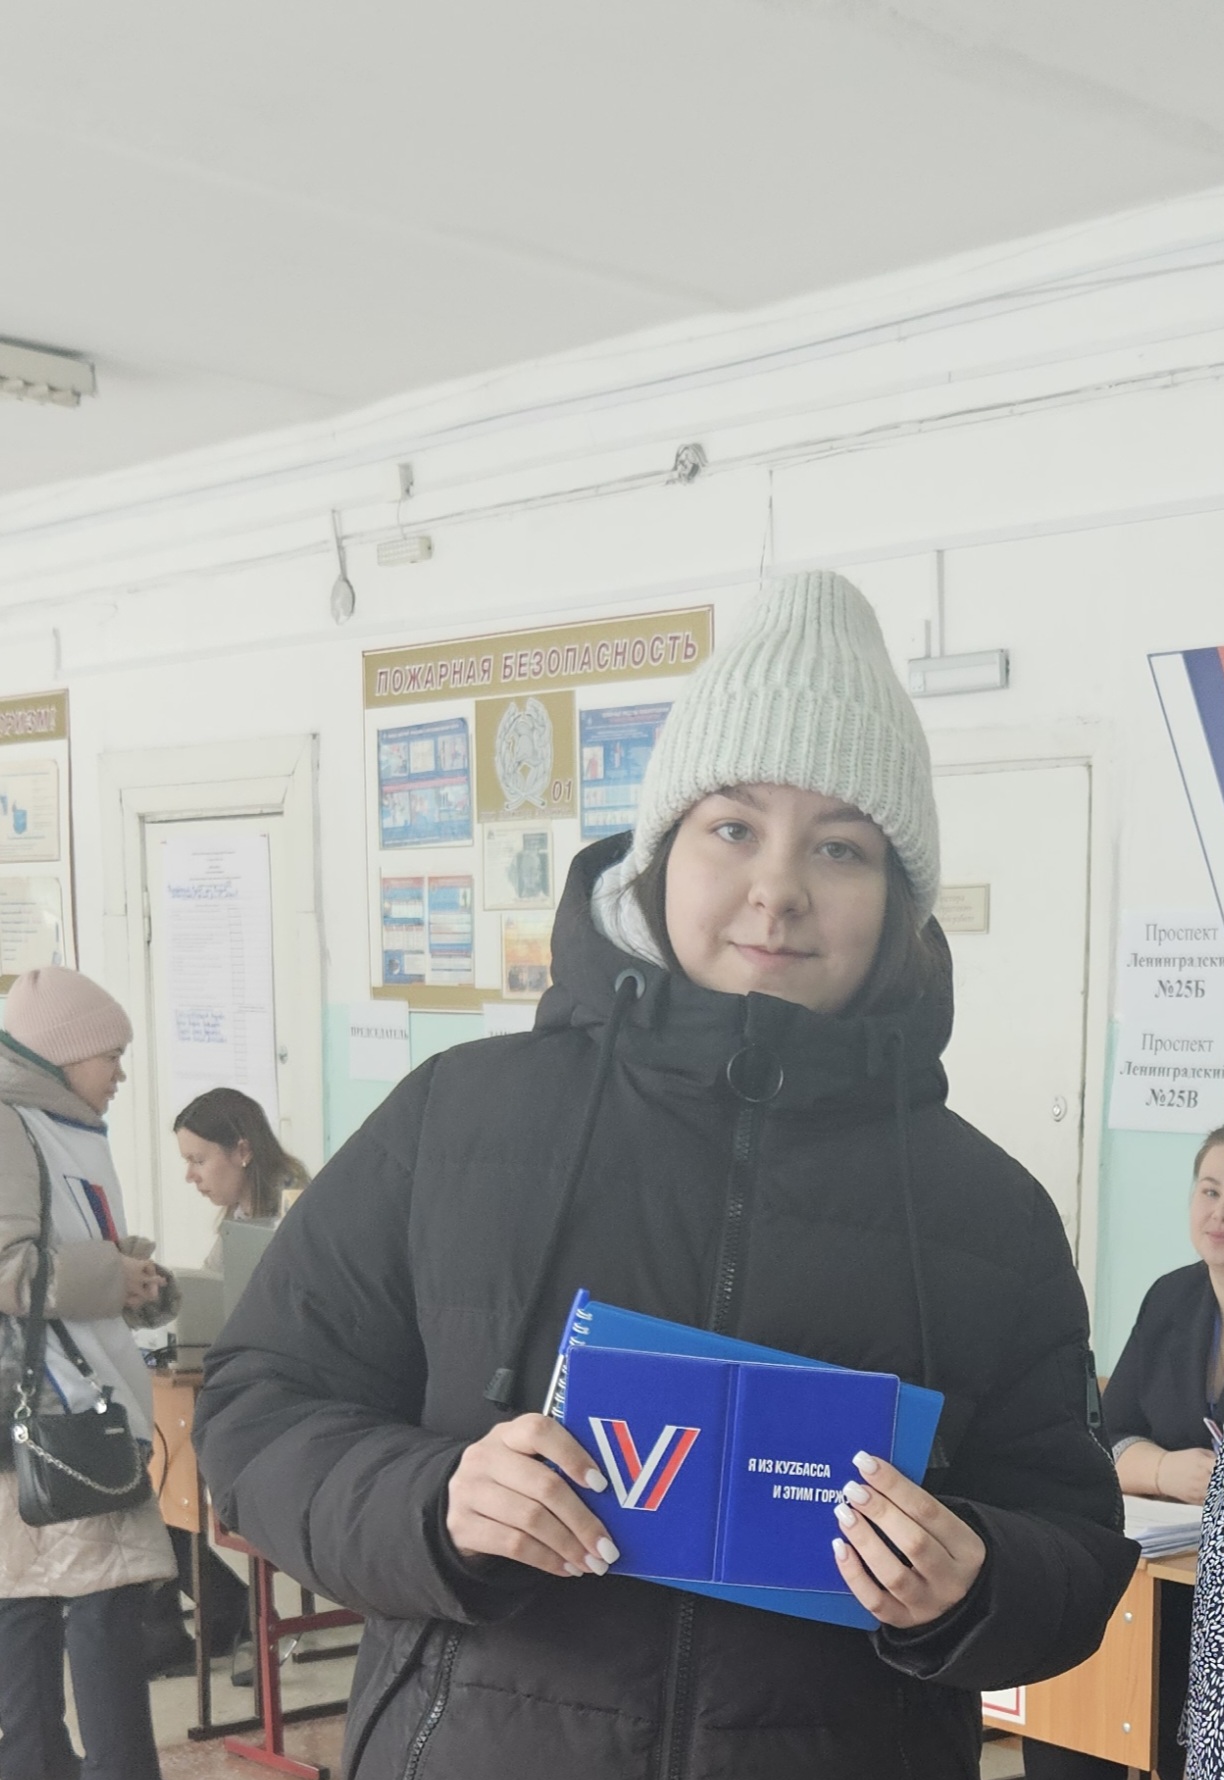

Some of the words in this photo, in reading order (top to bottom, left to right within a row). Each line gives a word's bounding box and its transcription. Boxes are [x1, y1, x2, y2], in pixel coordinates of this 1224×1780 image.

[375, 656, 492, 697] ПОЖАРНАЯ
[500, 631, 698, 682] БЕЗОПАСНОСТЬ
[552, 778, 573, 803] 01
[1144, 923, 1219, 946] Проспект
[1154, 979, 1206, 999] №25Б
[350, 1026, 409, 1040] ПРЕДСЕДАТЕЛЬ
[1141, 1033, 1214, 1056] Проспект
[1146, 1088, 1199, 1109] №25В
[748, 1458, 757, 1472] Я
[758, 1459, 773, 1474] ИЗ
[772, 1484, 782, 1499] И
[782, 1485, 814, 1501] ЭТИМ
[815, 1488, 849, 1504] ГОРЖ
